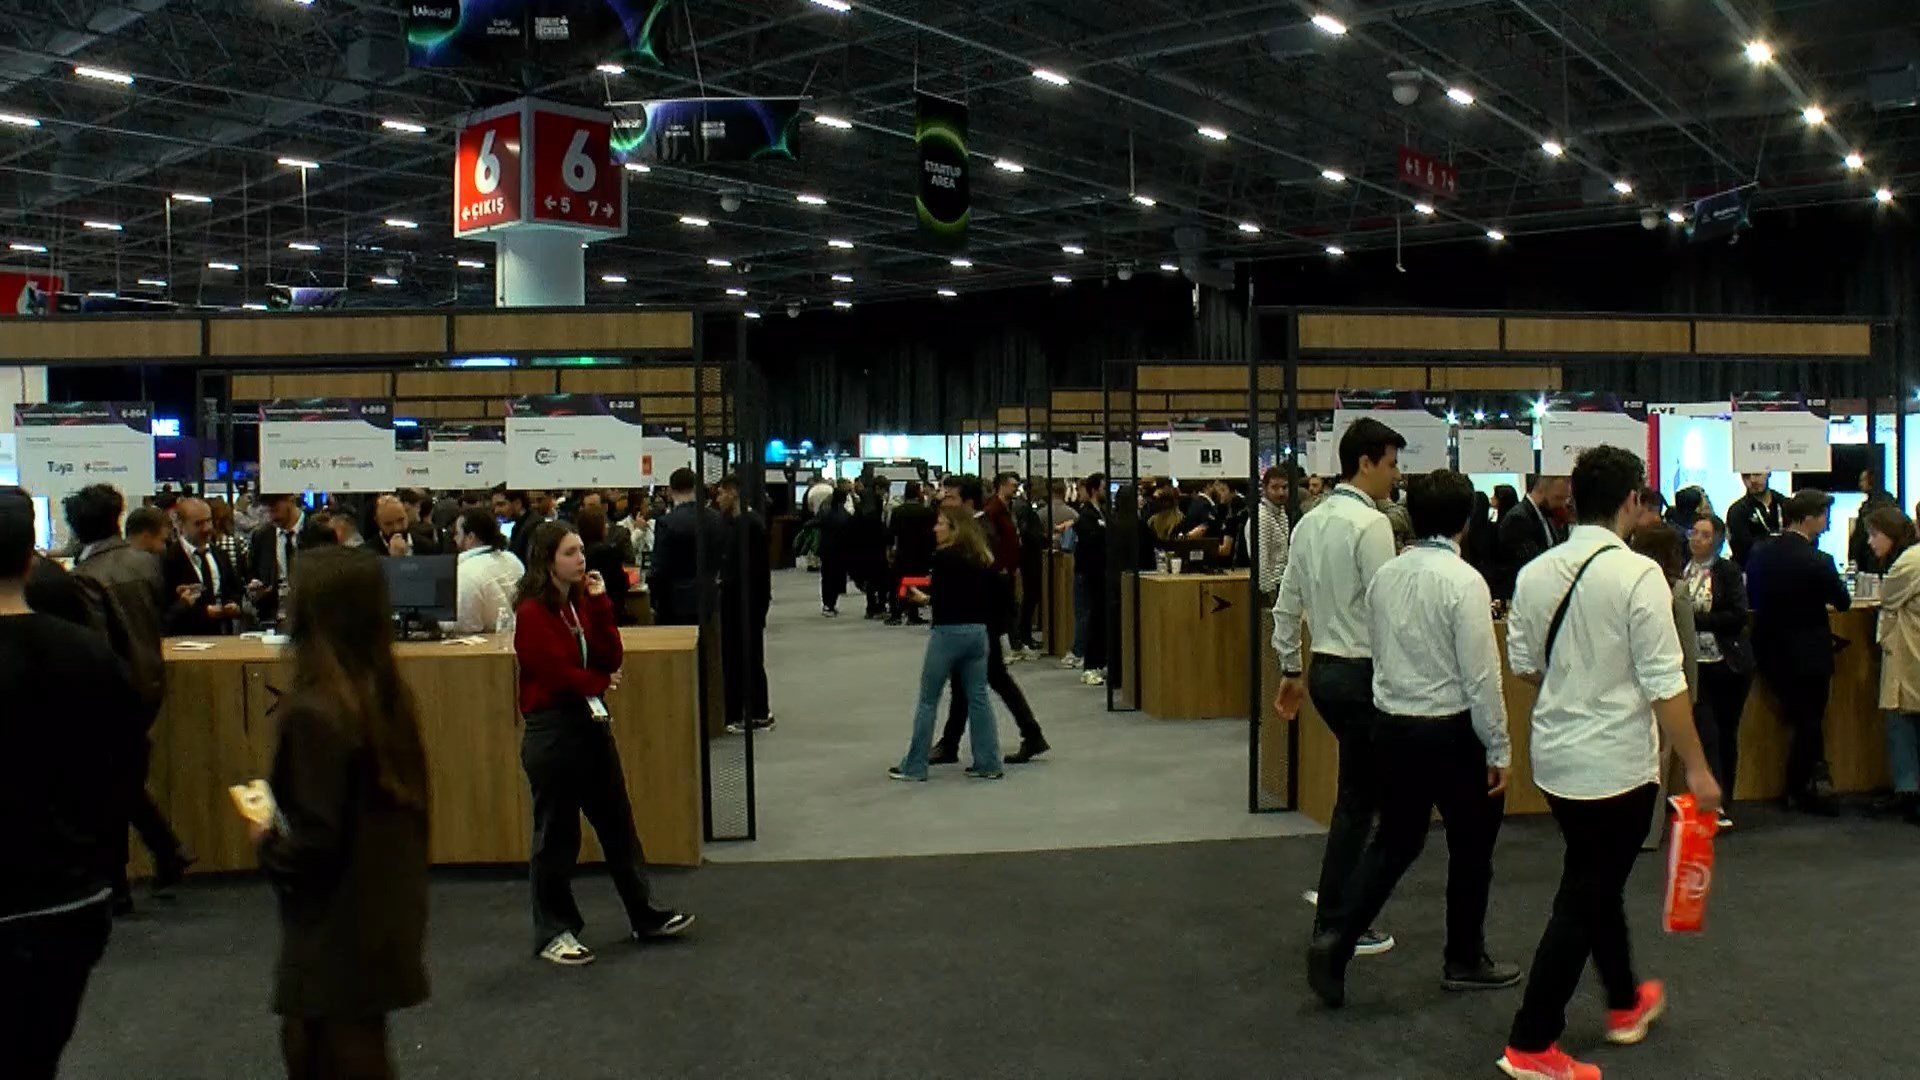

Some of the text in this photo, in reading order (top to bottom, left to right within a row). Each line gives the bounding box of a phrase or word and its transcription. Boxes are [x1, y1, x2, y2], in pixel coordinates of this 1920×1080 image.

[474, 129, 501, 194] 6
[562, 129, 597, 193] 6
[930, 173, 957, 188] AREA
[471, 197, 505, 220] ÇIKIŞ
[560, 197, 599, 217] 5 7
